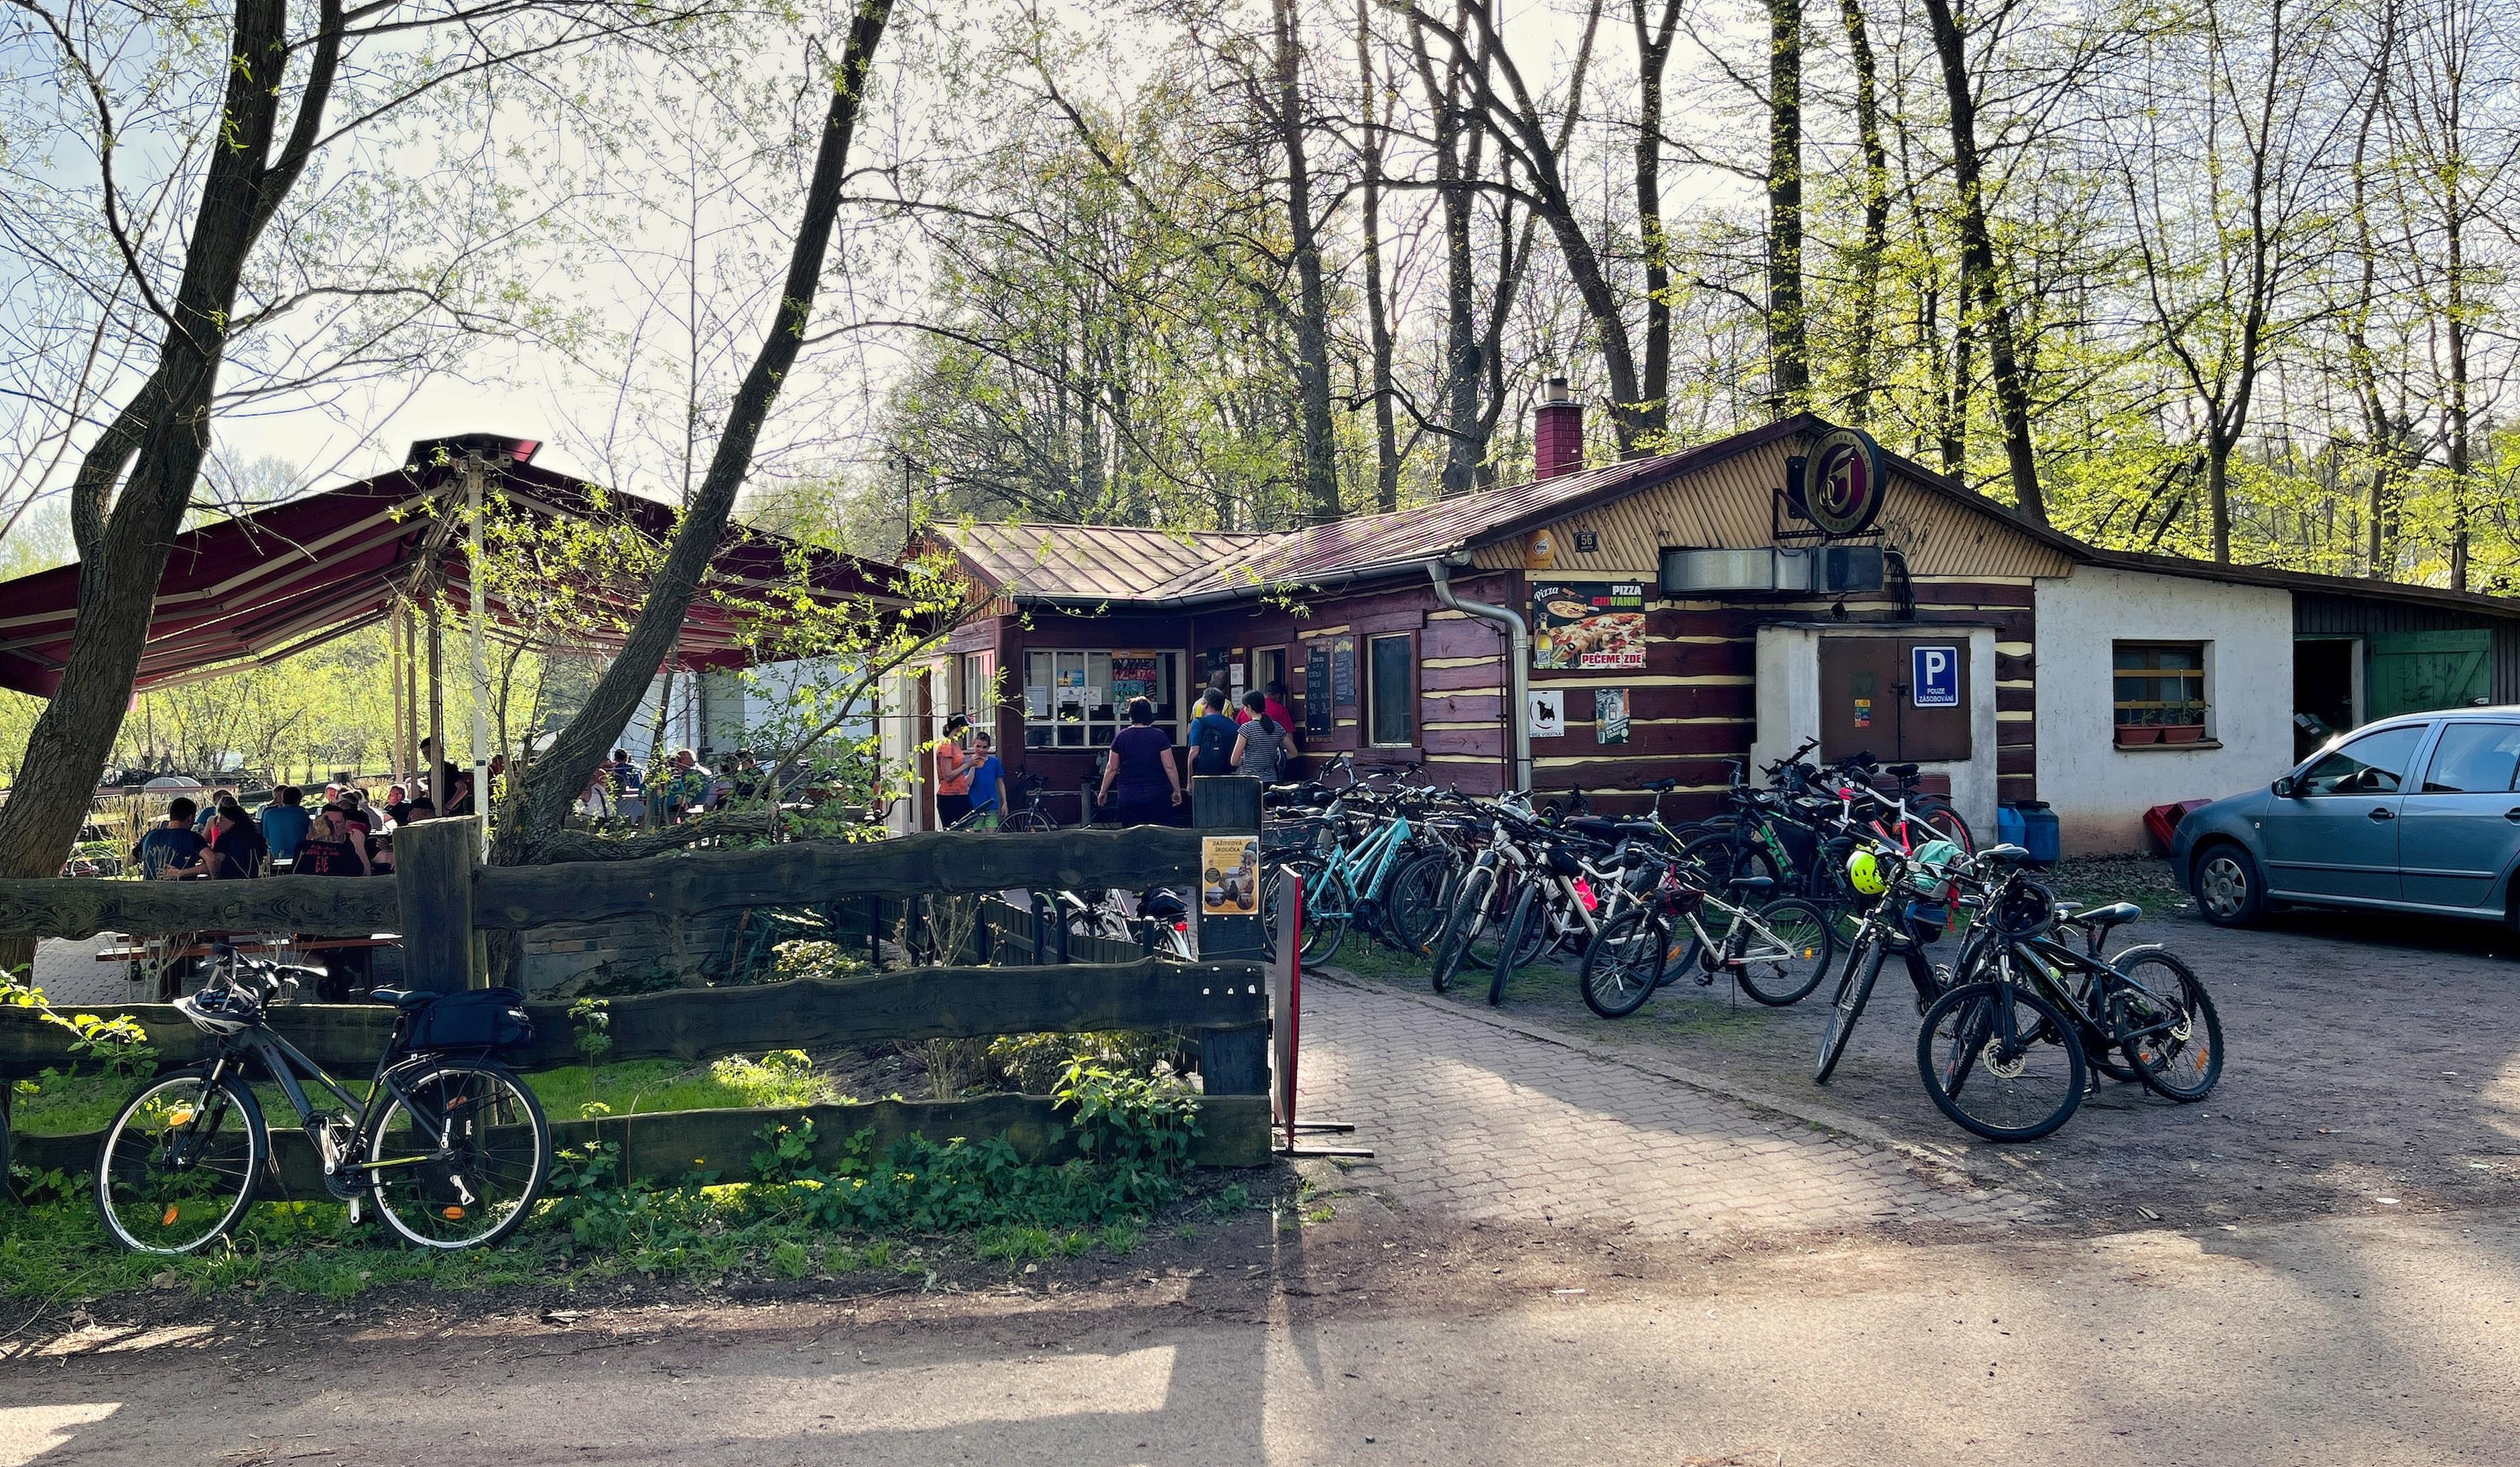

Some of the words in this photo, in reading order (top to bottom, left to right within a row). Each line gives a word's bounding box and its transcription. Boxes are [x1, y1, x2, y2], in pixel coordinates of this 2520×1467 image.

[1581, 534, 1593, 546] 56
[1533, 586, 1559, 602] Pizza
[1612, 585, 1642, 595] PIZZA
[1592, 596, 1642, 606] GIOVANNI
[1582, 651, 1621, 663] PEČEME
[1623, 655, 1642, 663] ZDE
[1926, 651, 1946, 686] P
[1919, 694, 1954, 702] ZÁSOBOVÁNÍ
